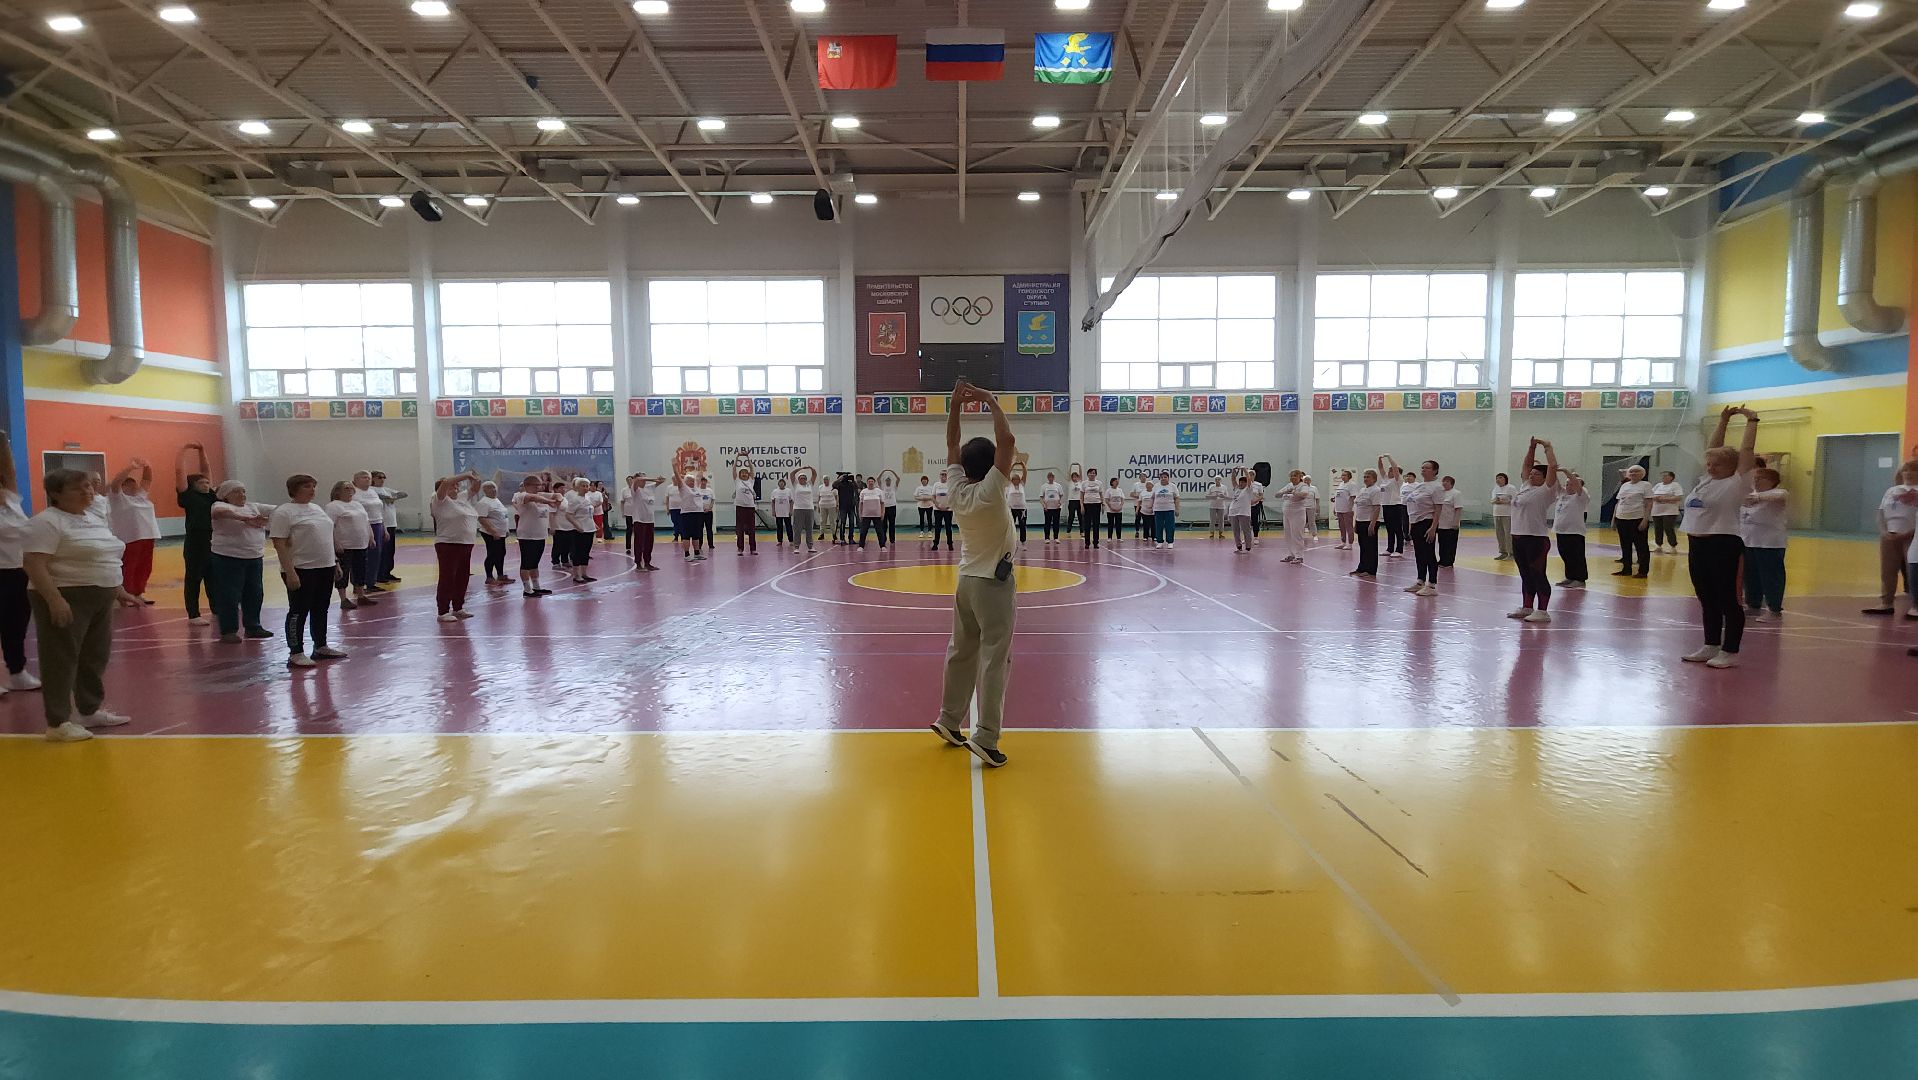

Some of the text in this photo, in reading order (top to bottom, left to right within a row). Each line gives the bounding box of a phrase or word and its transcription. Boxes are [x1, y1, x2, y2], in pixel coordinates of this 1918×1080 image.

[719, 446, 807, 455] ПРАВИТЕЛЬСТВО
[1128, 453, 1244, 466] АДМИНИСТРАЦИЯ
[1117, 468, 1204, 480] ГОРОДКОГО
